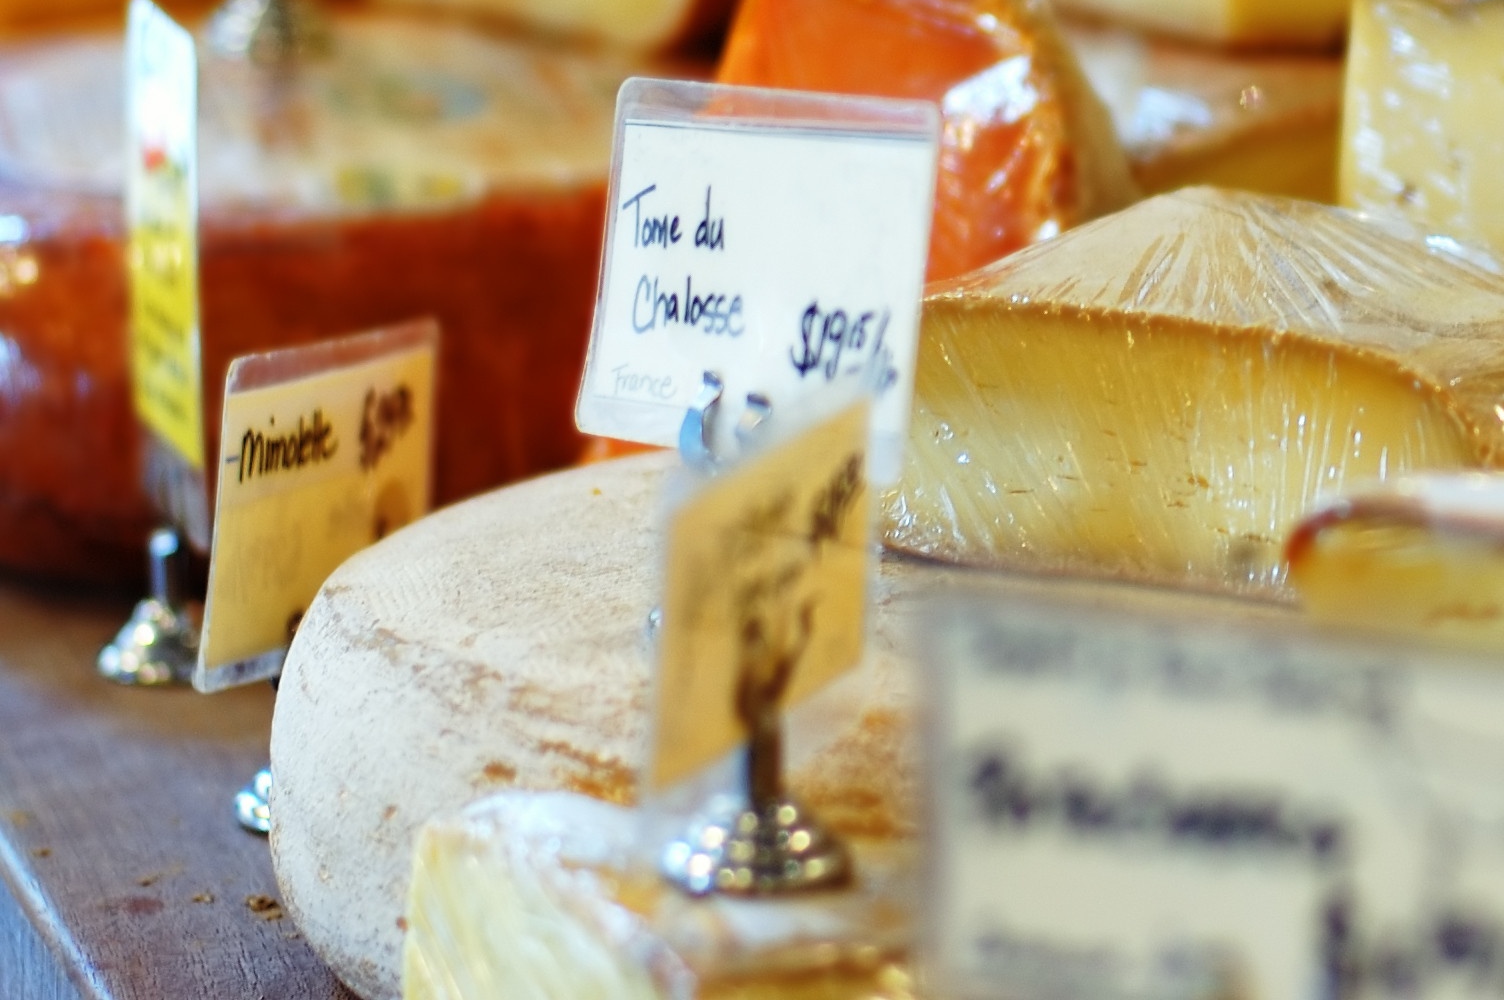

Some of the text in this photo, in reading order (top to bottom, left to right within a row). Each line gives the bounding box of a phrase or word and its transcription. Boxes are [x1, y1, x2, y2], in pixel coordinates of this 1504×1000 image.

[694, 184, 725, 250] du
[631, 273, 748, 336] Chalosse
[611, 362, 679, 400] France
